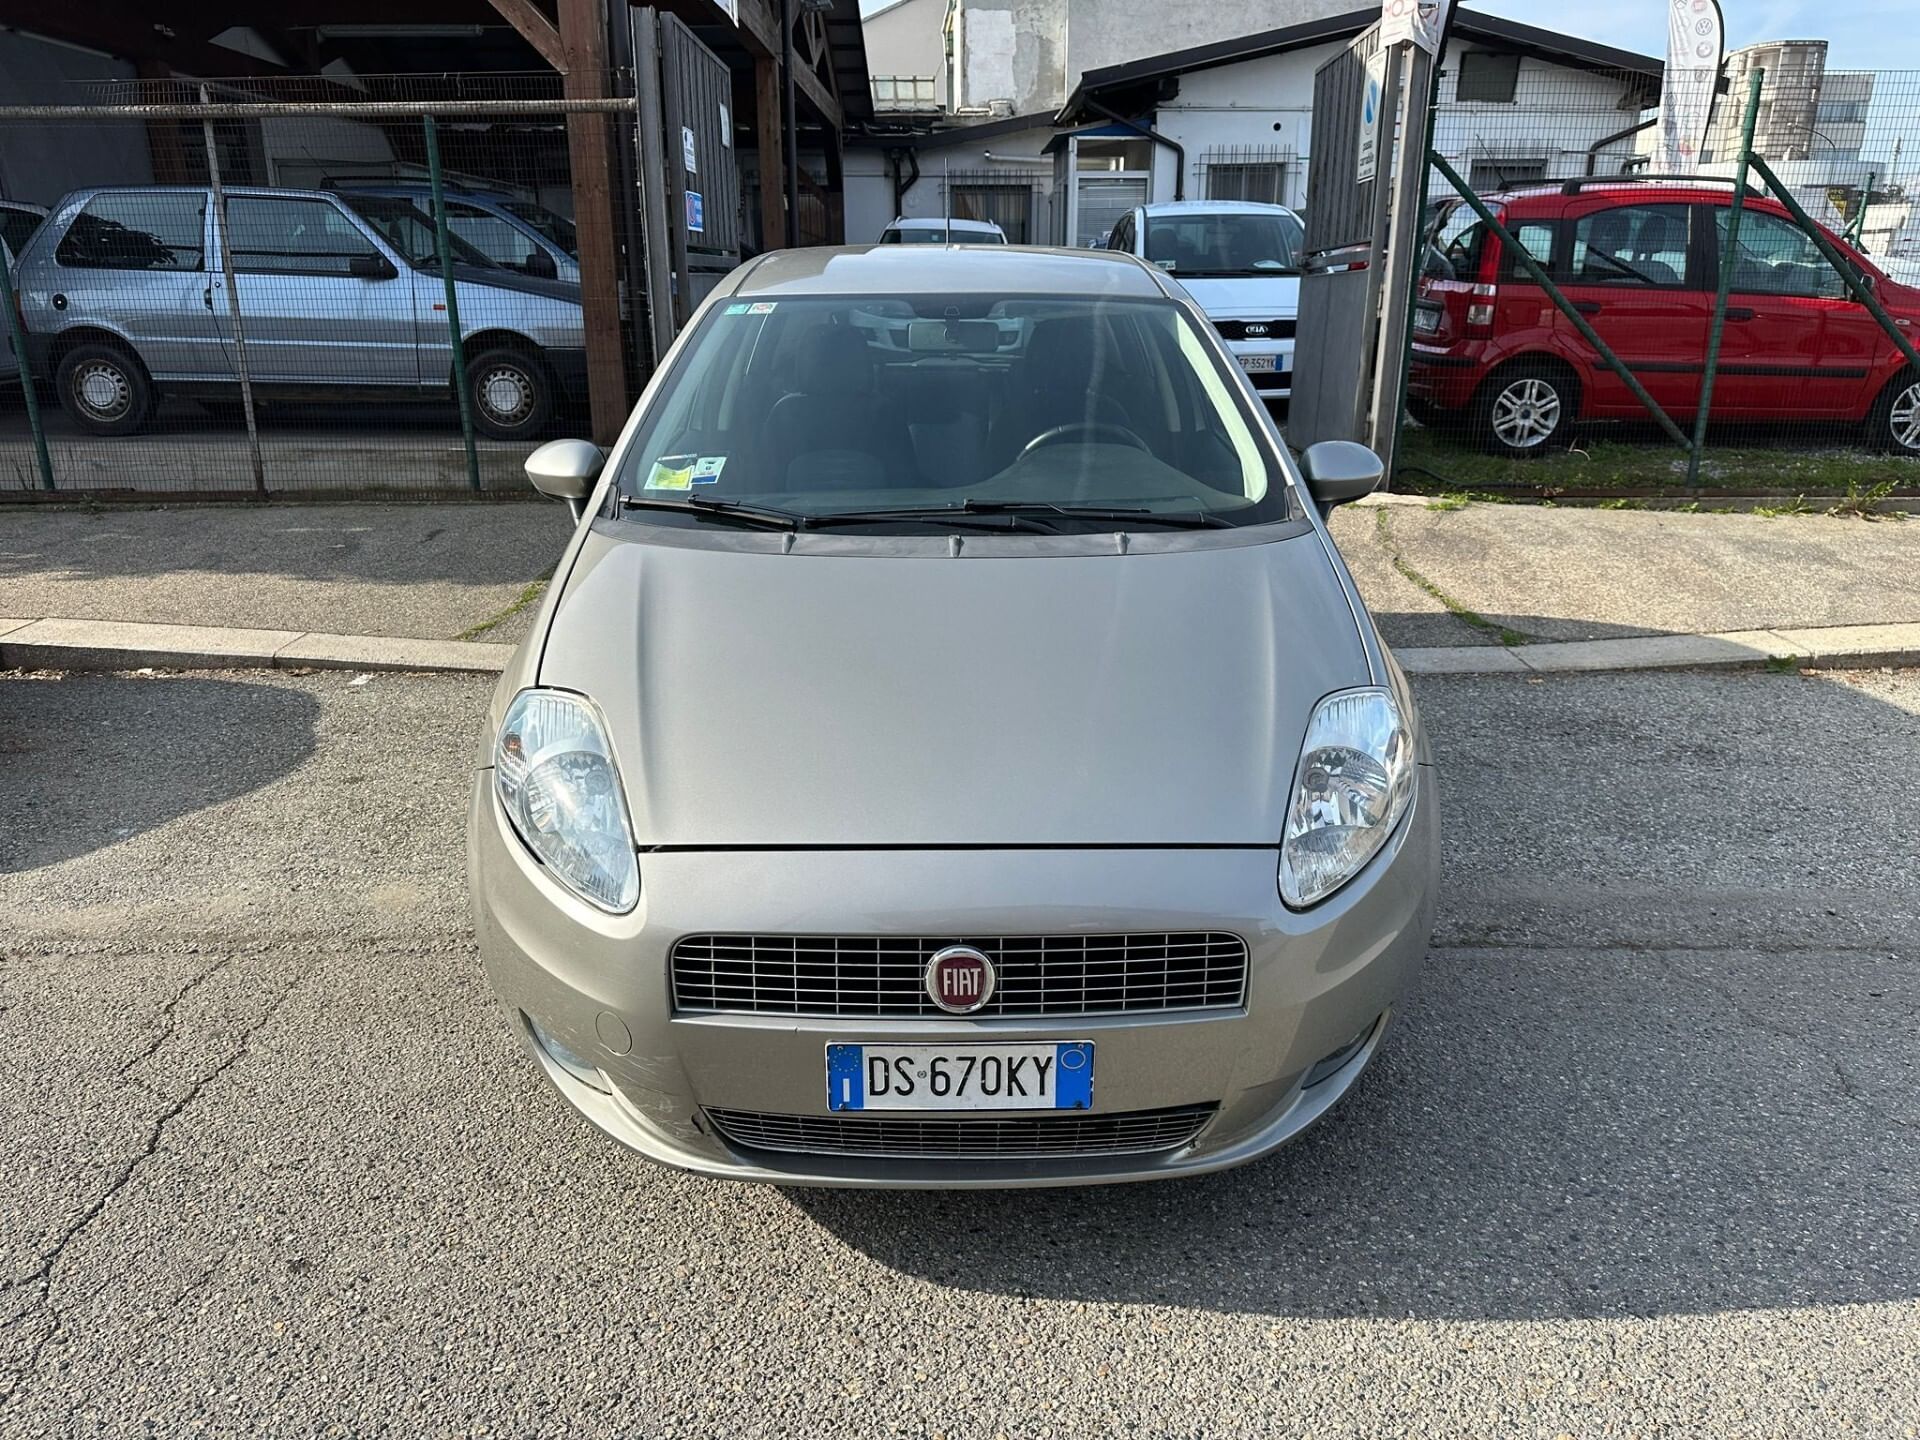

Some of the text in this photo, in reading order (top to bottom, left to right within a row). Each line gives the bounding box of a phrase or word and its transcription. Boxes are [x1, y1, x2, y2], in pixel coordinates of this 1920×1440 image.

[943, 967, 981, 996] FIAT
[843, 1078, 850, 1102] I
[868, 1055, 1053, 1097] DS 670KY
